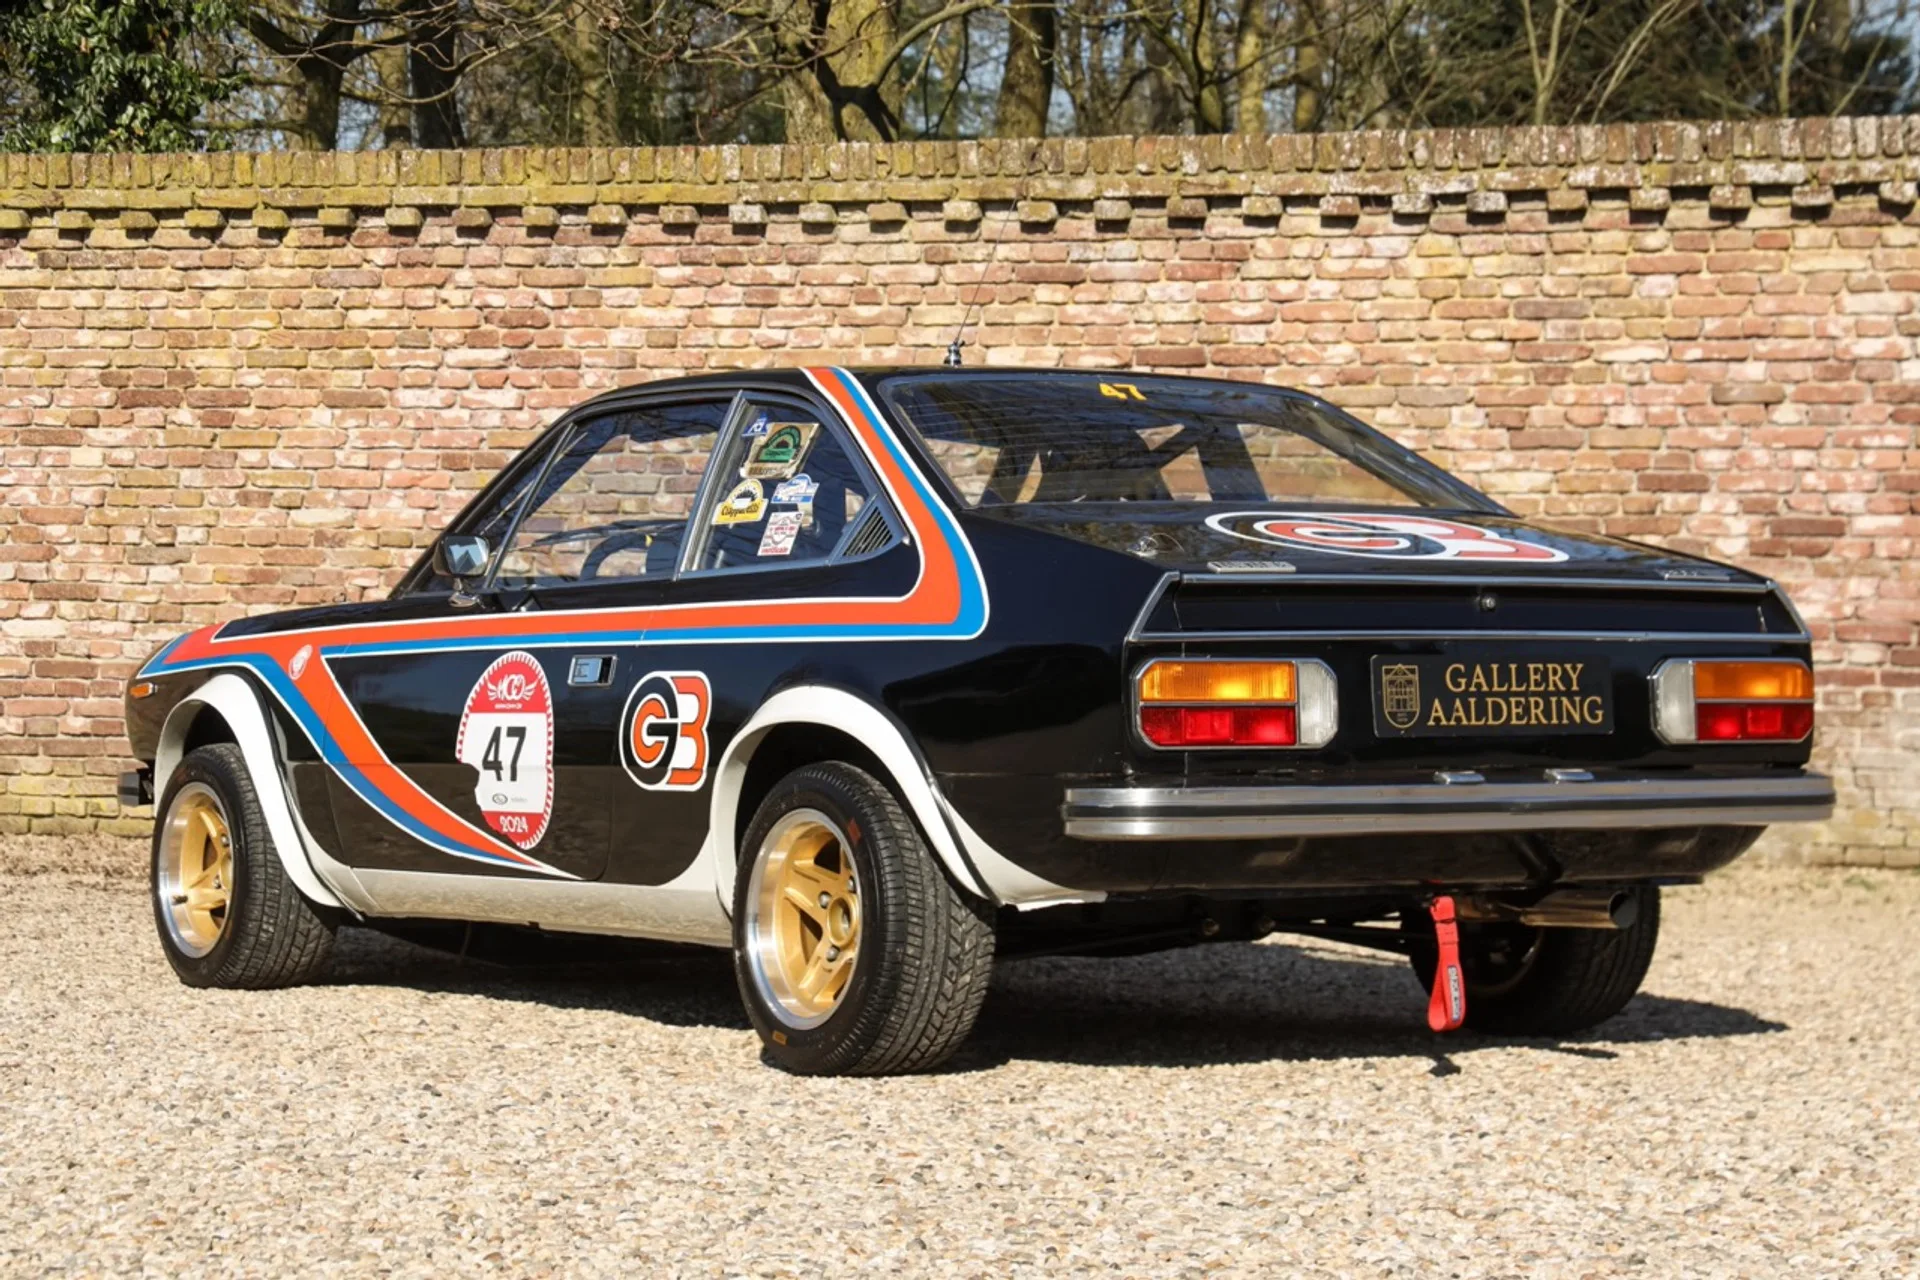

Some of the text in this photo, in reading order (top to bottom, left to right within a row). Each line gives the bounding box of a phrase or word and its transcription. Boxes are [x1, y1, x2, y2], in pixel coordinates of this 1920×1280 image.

[1099, 383, 1147, 400] 47
[1445, 663, 1583, 693] GALLERY
[1426, 696, 1604, 726] AALDERING
[482, 726, 526, 781] 47
[500, 816, 528, 832] 2024
